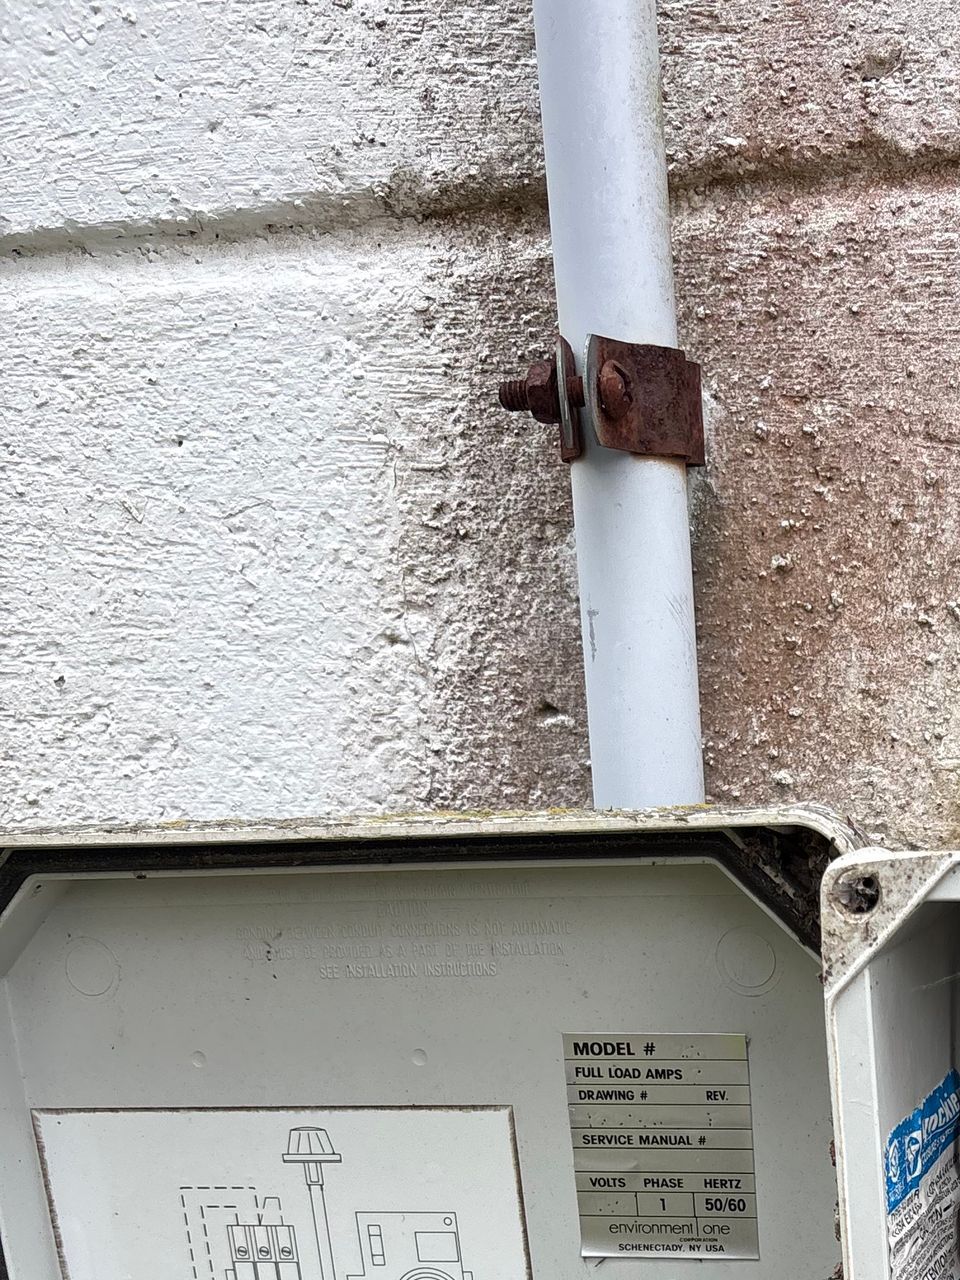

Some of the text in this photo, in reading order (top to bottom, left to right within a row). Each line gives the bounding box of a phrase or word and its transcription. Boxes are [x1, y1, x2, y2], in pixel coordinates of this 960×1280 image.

[320, 962, 497, 980] SEE INSTALLATION INSTRUCTIONS
[573, 1042, 656, 1056] MODEL #
[575, 1067, 683, 1080] FULL LOAD AMPS
[578, 1090, 648, 1101] DRAWING #
[706, 1090, 729, 1101] REV.
[582, 1134, 706, 1146] SERVICE MANUAL #
[589, 1177, 626, 1188] VOLTS
[643, 1178, 684, 1189] PHASE
[704, 1178, 742, 1189] HERTZ
[660, 1198, 666, 1211] 1
[705, 1198, 746, 1213] 50/60
[609, 1221, 730, 1235] environment one
[618, 1243, 725, 1253] SCHENECTADY, NY USA
